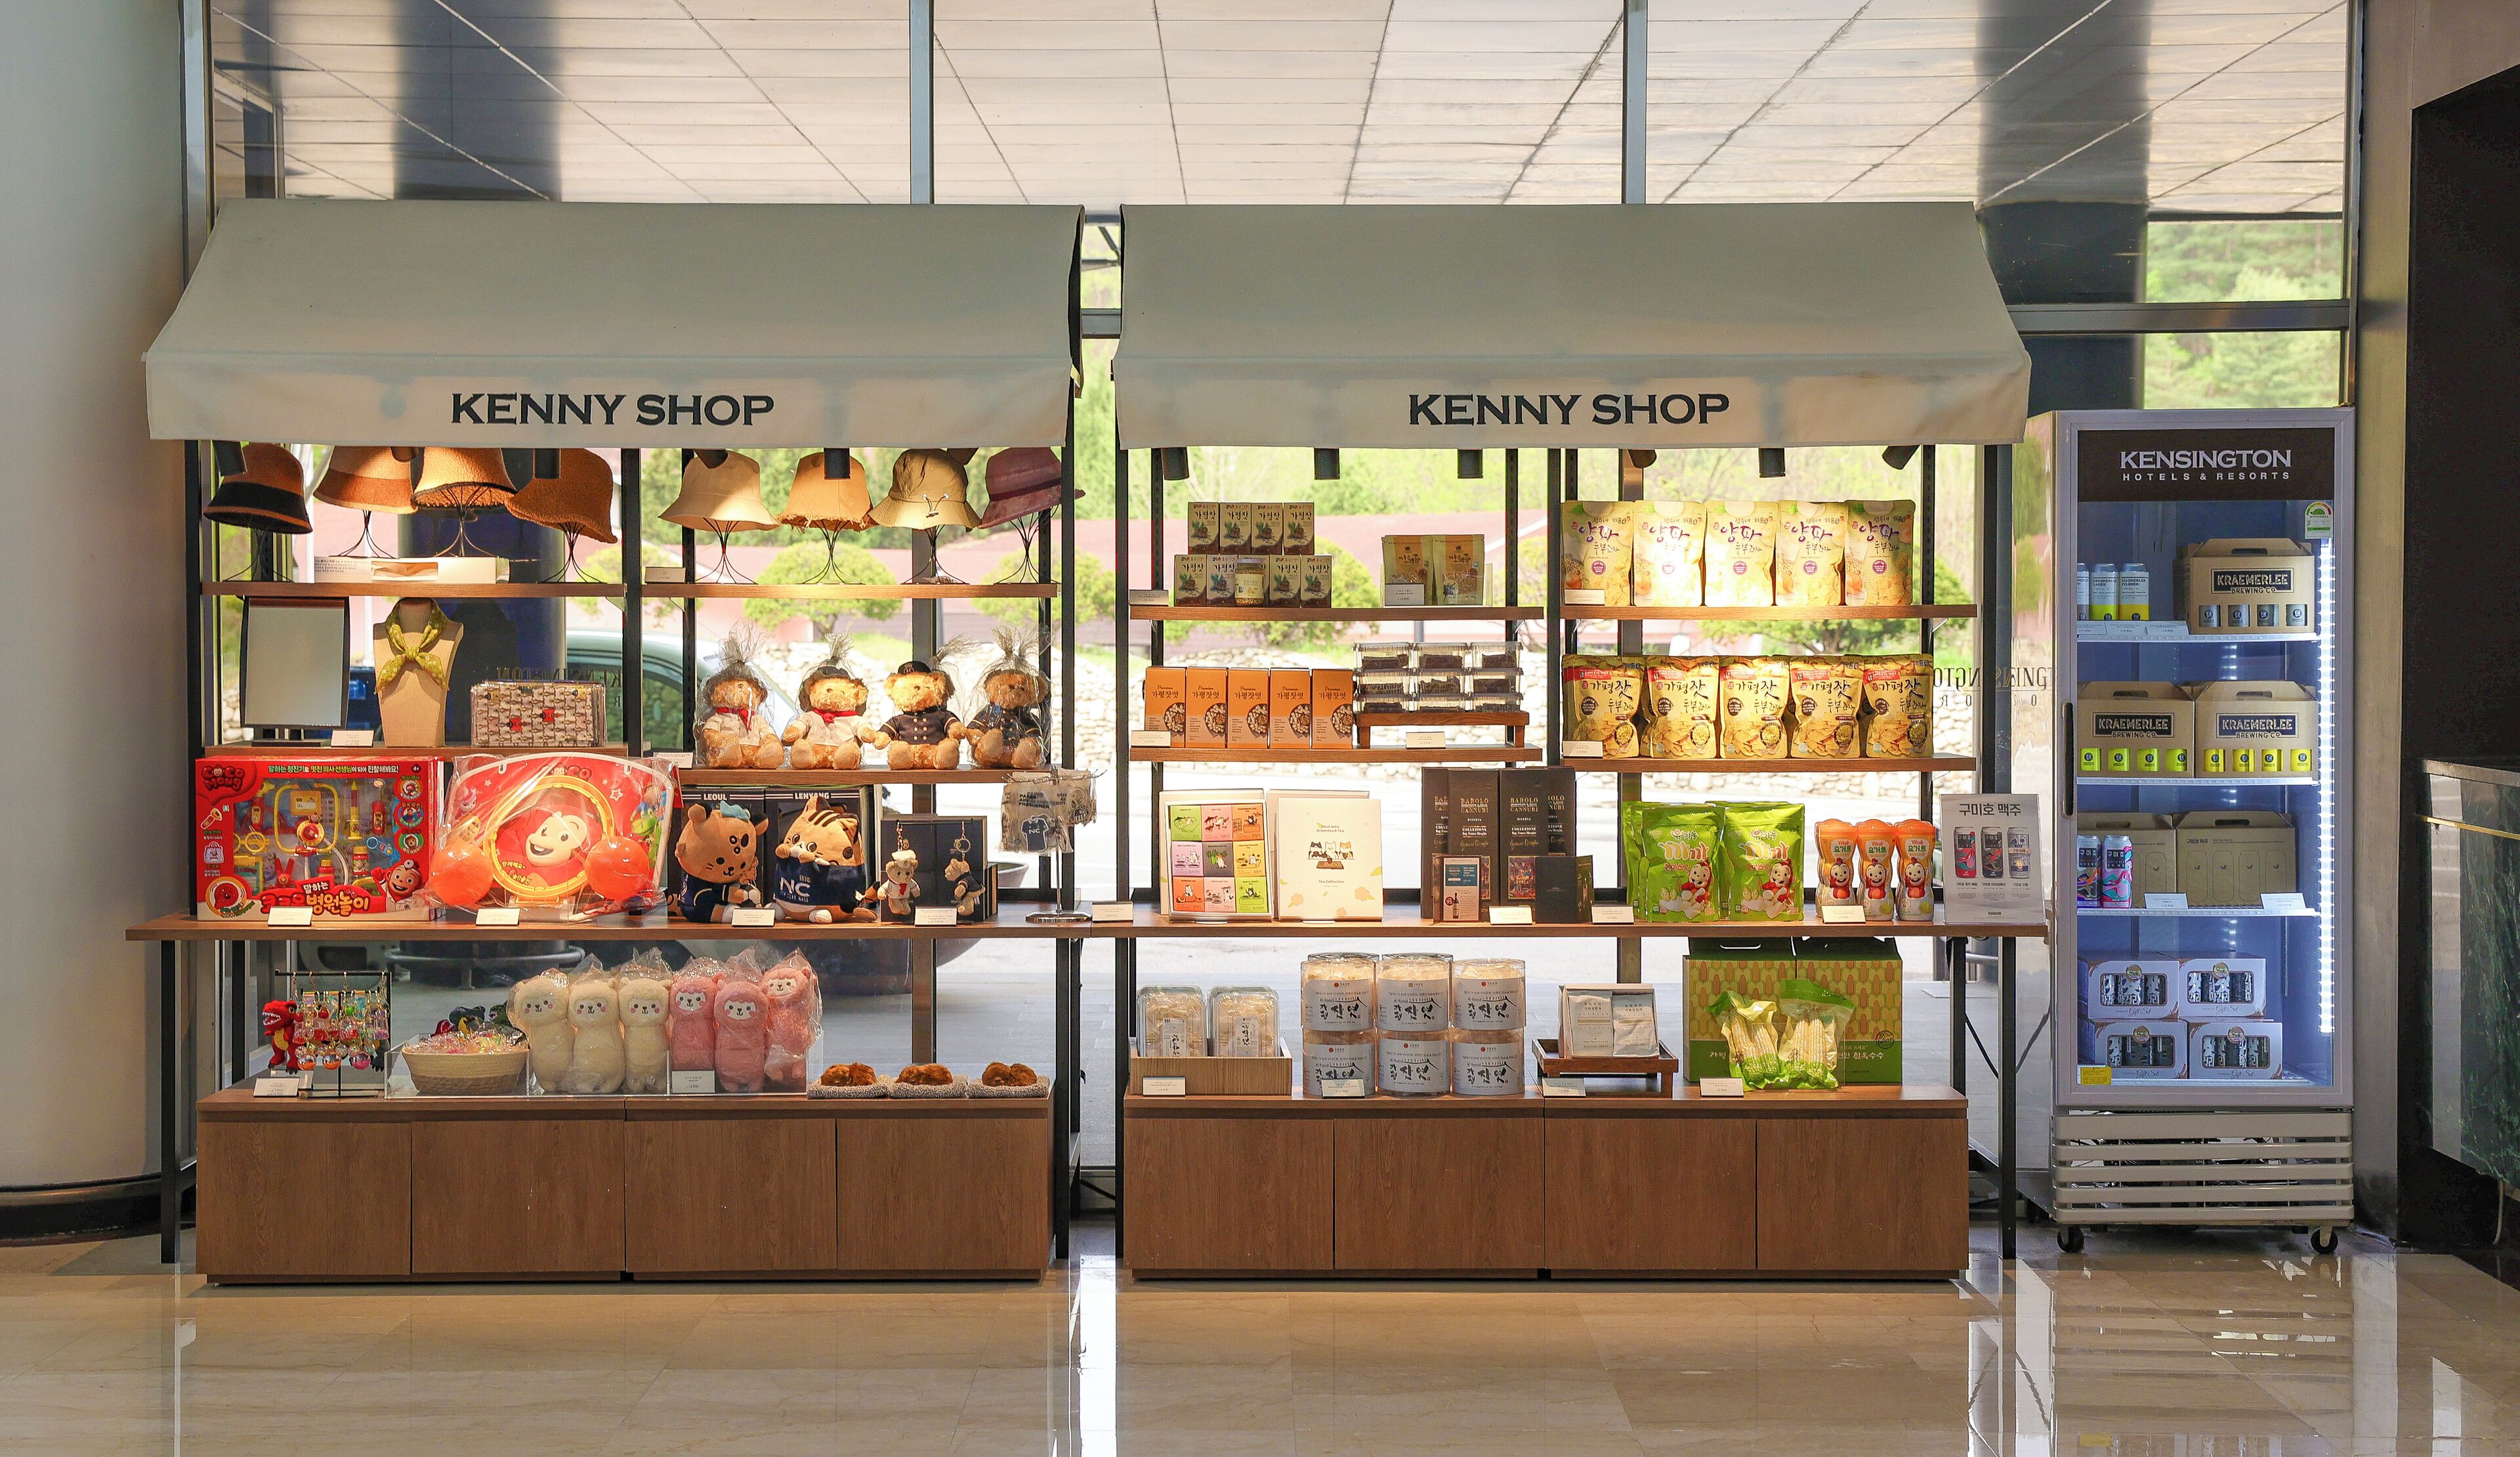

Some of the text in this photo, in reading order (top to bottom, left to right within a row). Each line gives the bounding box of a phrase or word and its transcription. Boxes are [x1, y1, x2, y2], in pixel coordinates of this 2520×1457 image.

[451, 392, 774, 426] KENNY SHOP
[1409, 393, 1729, 426] KENNY SHOP
[2120, 450, 2292, 469] KENSINGTON
[1579, 521, 1619, 542] 양파
[1649, 522, 1690, 543] 양파
[1720, 521, 1763, 543] 양파
[1791, 521, 1832, 543] 양파
[1859, 520, 1900, 541] 양파
[2217, 574, 2288, 585] KRAEMERLEE
[2099, 718, 2169, 730] KRAEMERLEE
[2222, 718, 2293, 730] KRAEMERLEE
[1959, 803, 2022, 817] 구미호 맥주
[1671, 829, 1698, 840] 유기농
[1750, 829, 1778, 840] 유기농
[303, 882, 329, 894] 말하는
[779, 876, 811, 897] NC
[306, 891, 369, 917] 병원놀이
